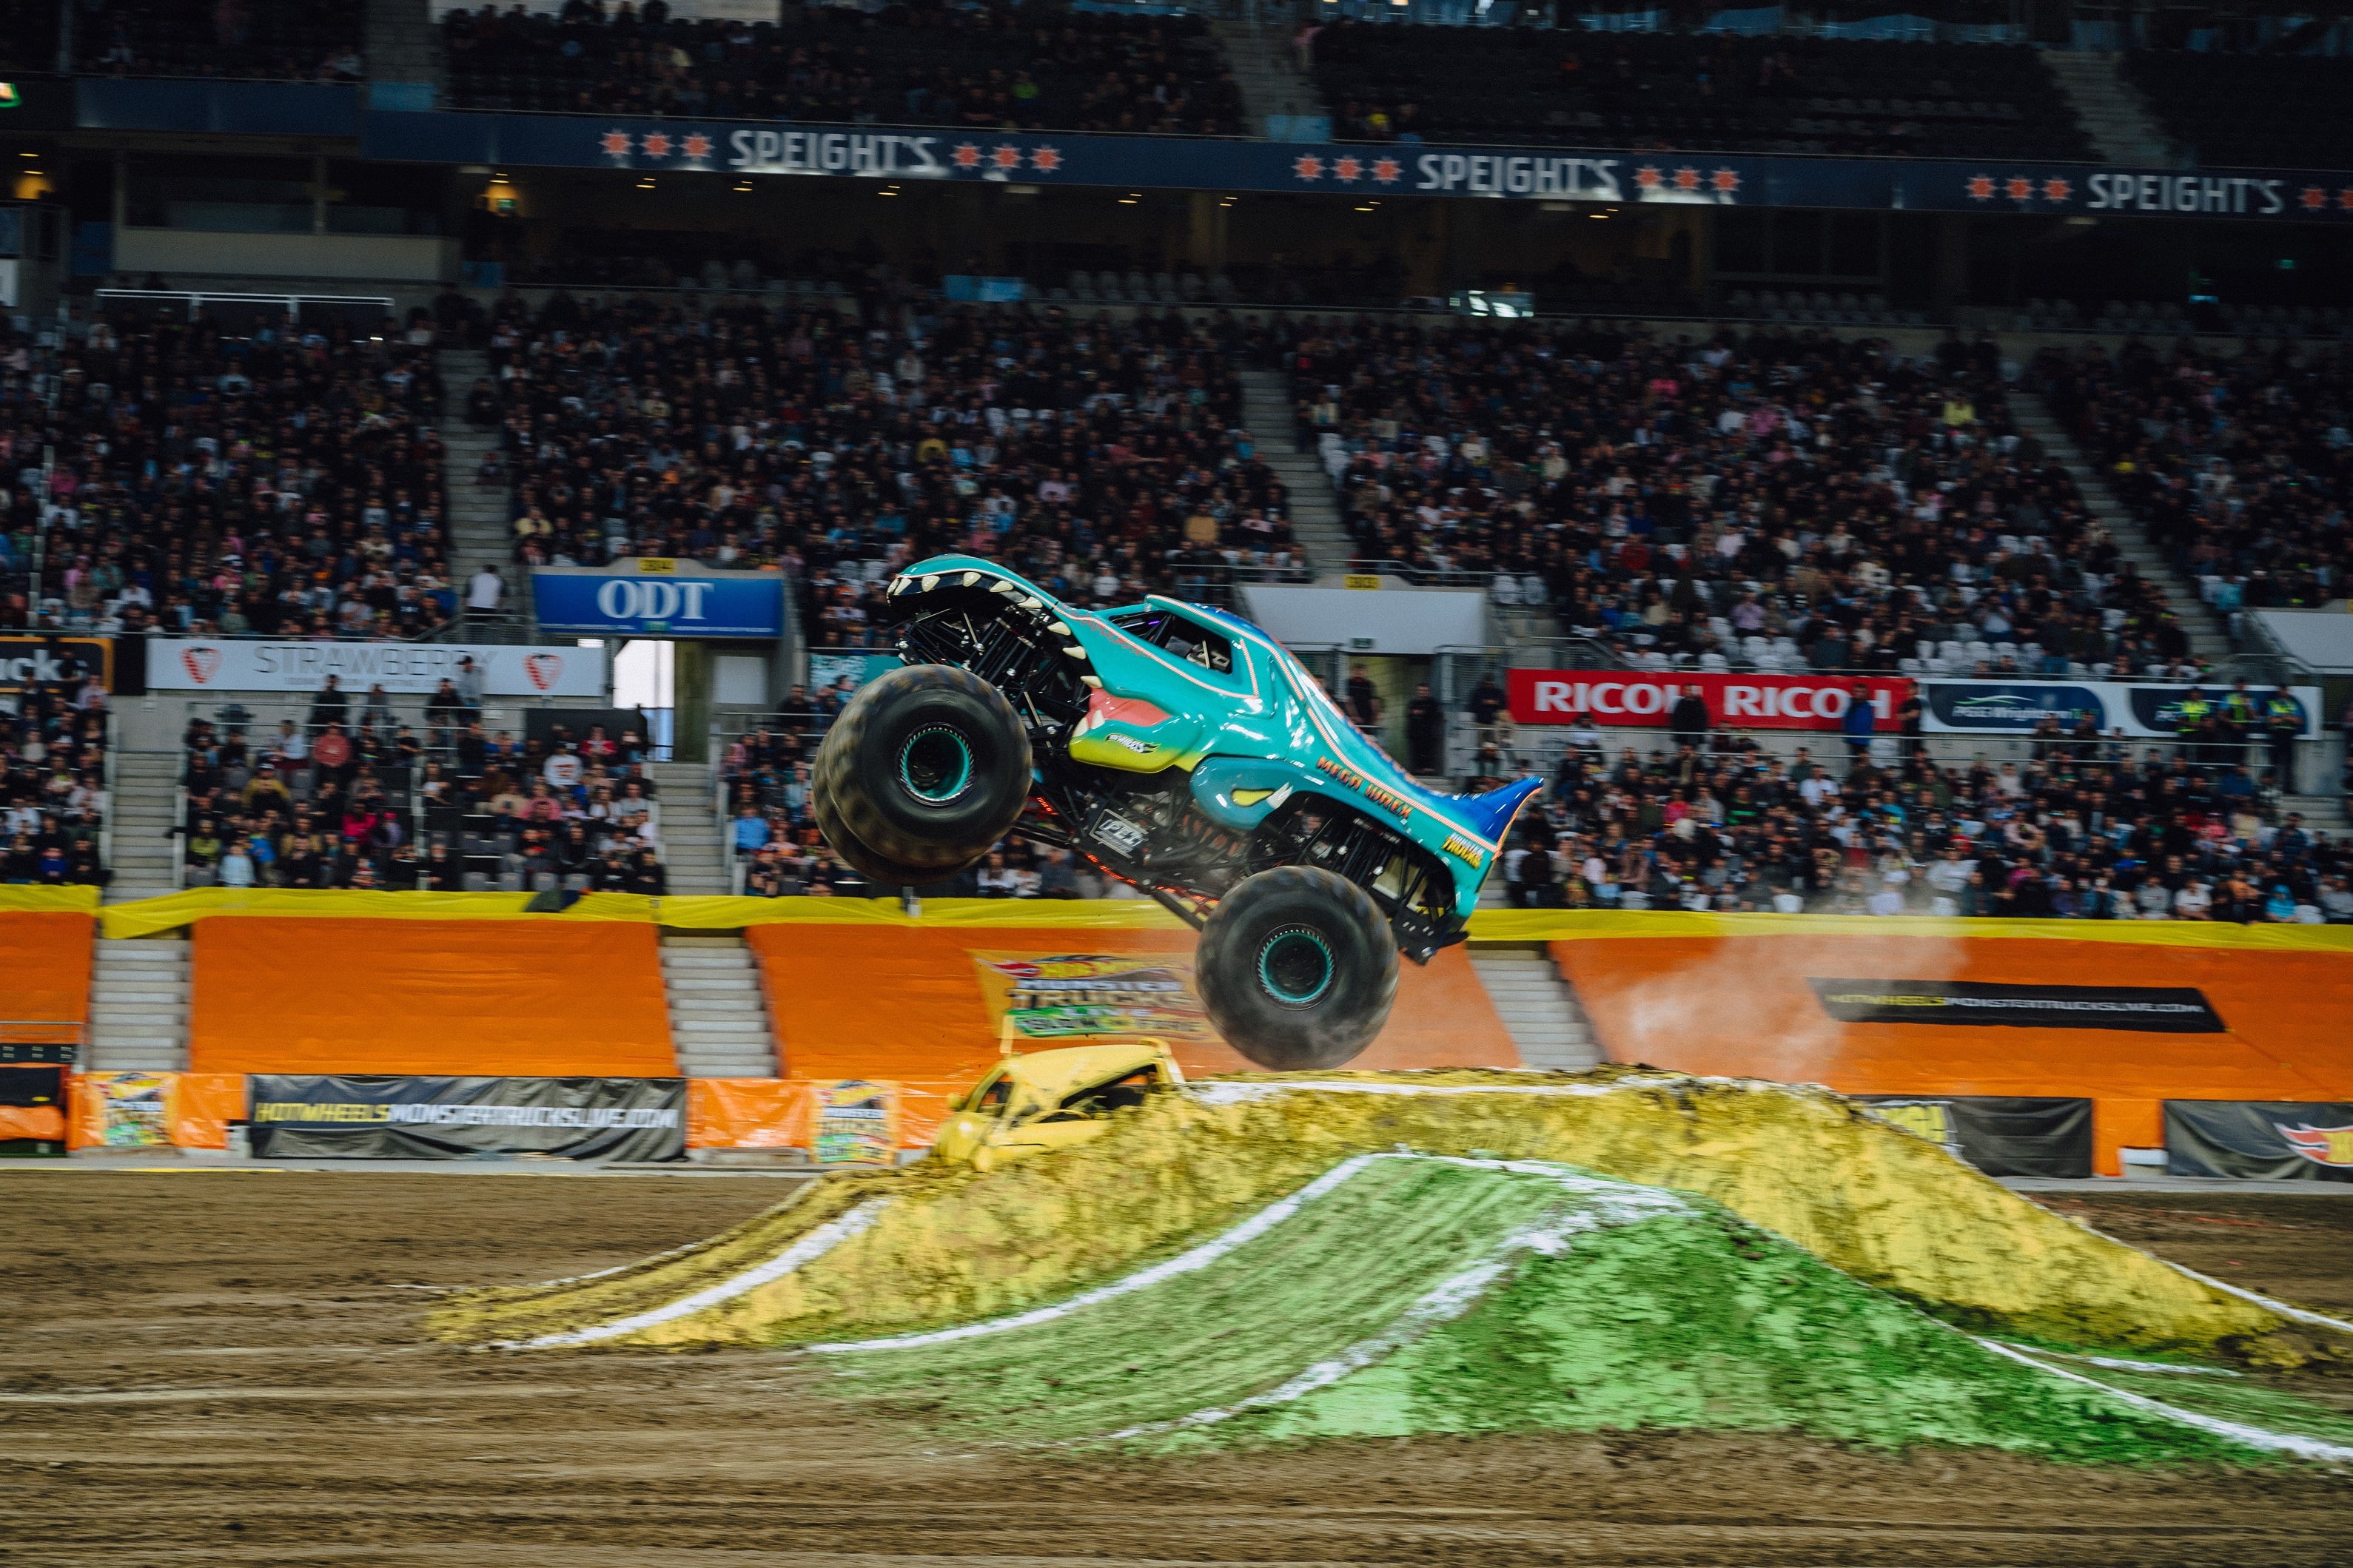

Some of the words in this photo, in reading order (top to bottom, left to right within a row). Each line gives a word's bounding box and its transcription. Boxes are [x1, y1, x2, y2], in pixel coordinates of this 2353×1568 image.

[729, 129, 938, 172] SPEIGHT'S
[1416, 154, 1620, 194] SPEIGHT'S
[2087, 174, 2285, 214] SPEIGHT'S
[597, 579, 714, 619] ODT
[0, 649, 88, 682] ck
[1317, 756, 1363, 792] MEGA
[1365, 783, 1413, 819] WREX
